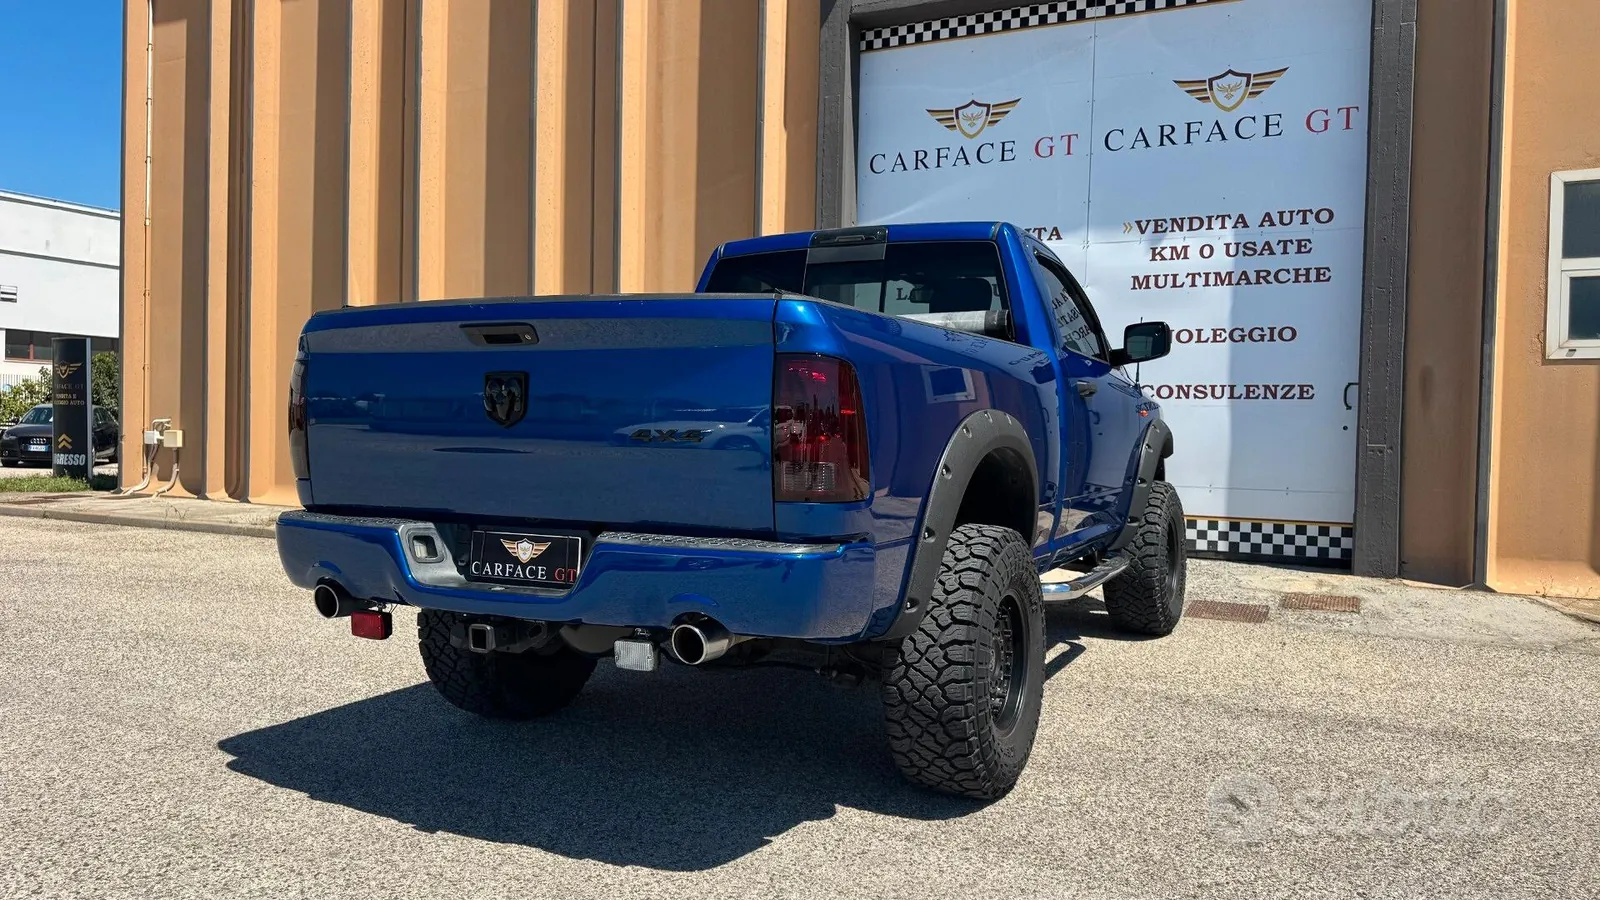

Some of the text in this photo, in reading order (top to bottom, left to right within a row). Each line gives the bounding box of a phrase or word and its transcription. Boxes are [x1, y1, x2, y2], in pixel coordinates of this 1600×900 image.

[1104, 106, 1361, 153] CARFACE GT
[869, 133, 1080, 174] CARFACE GT
[1135, 208, 1335, 235] VENDITA AUTO
[1149, 246, 1190, 262] KM
[1225, 239, 1313, 258] USATE
[1131, 267, 1332, 290] MULTIMARCHE
[1170, 327, 1297, 344] OLEGGIO
[471, 561, 577, 583] CARFACE GT
